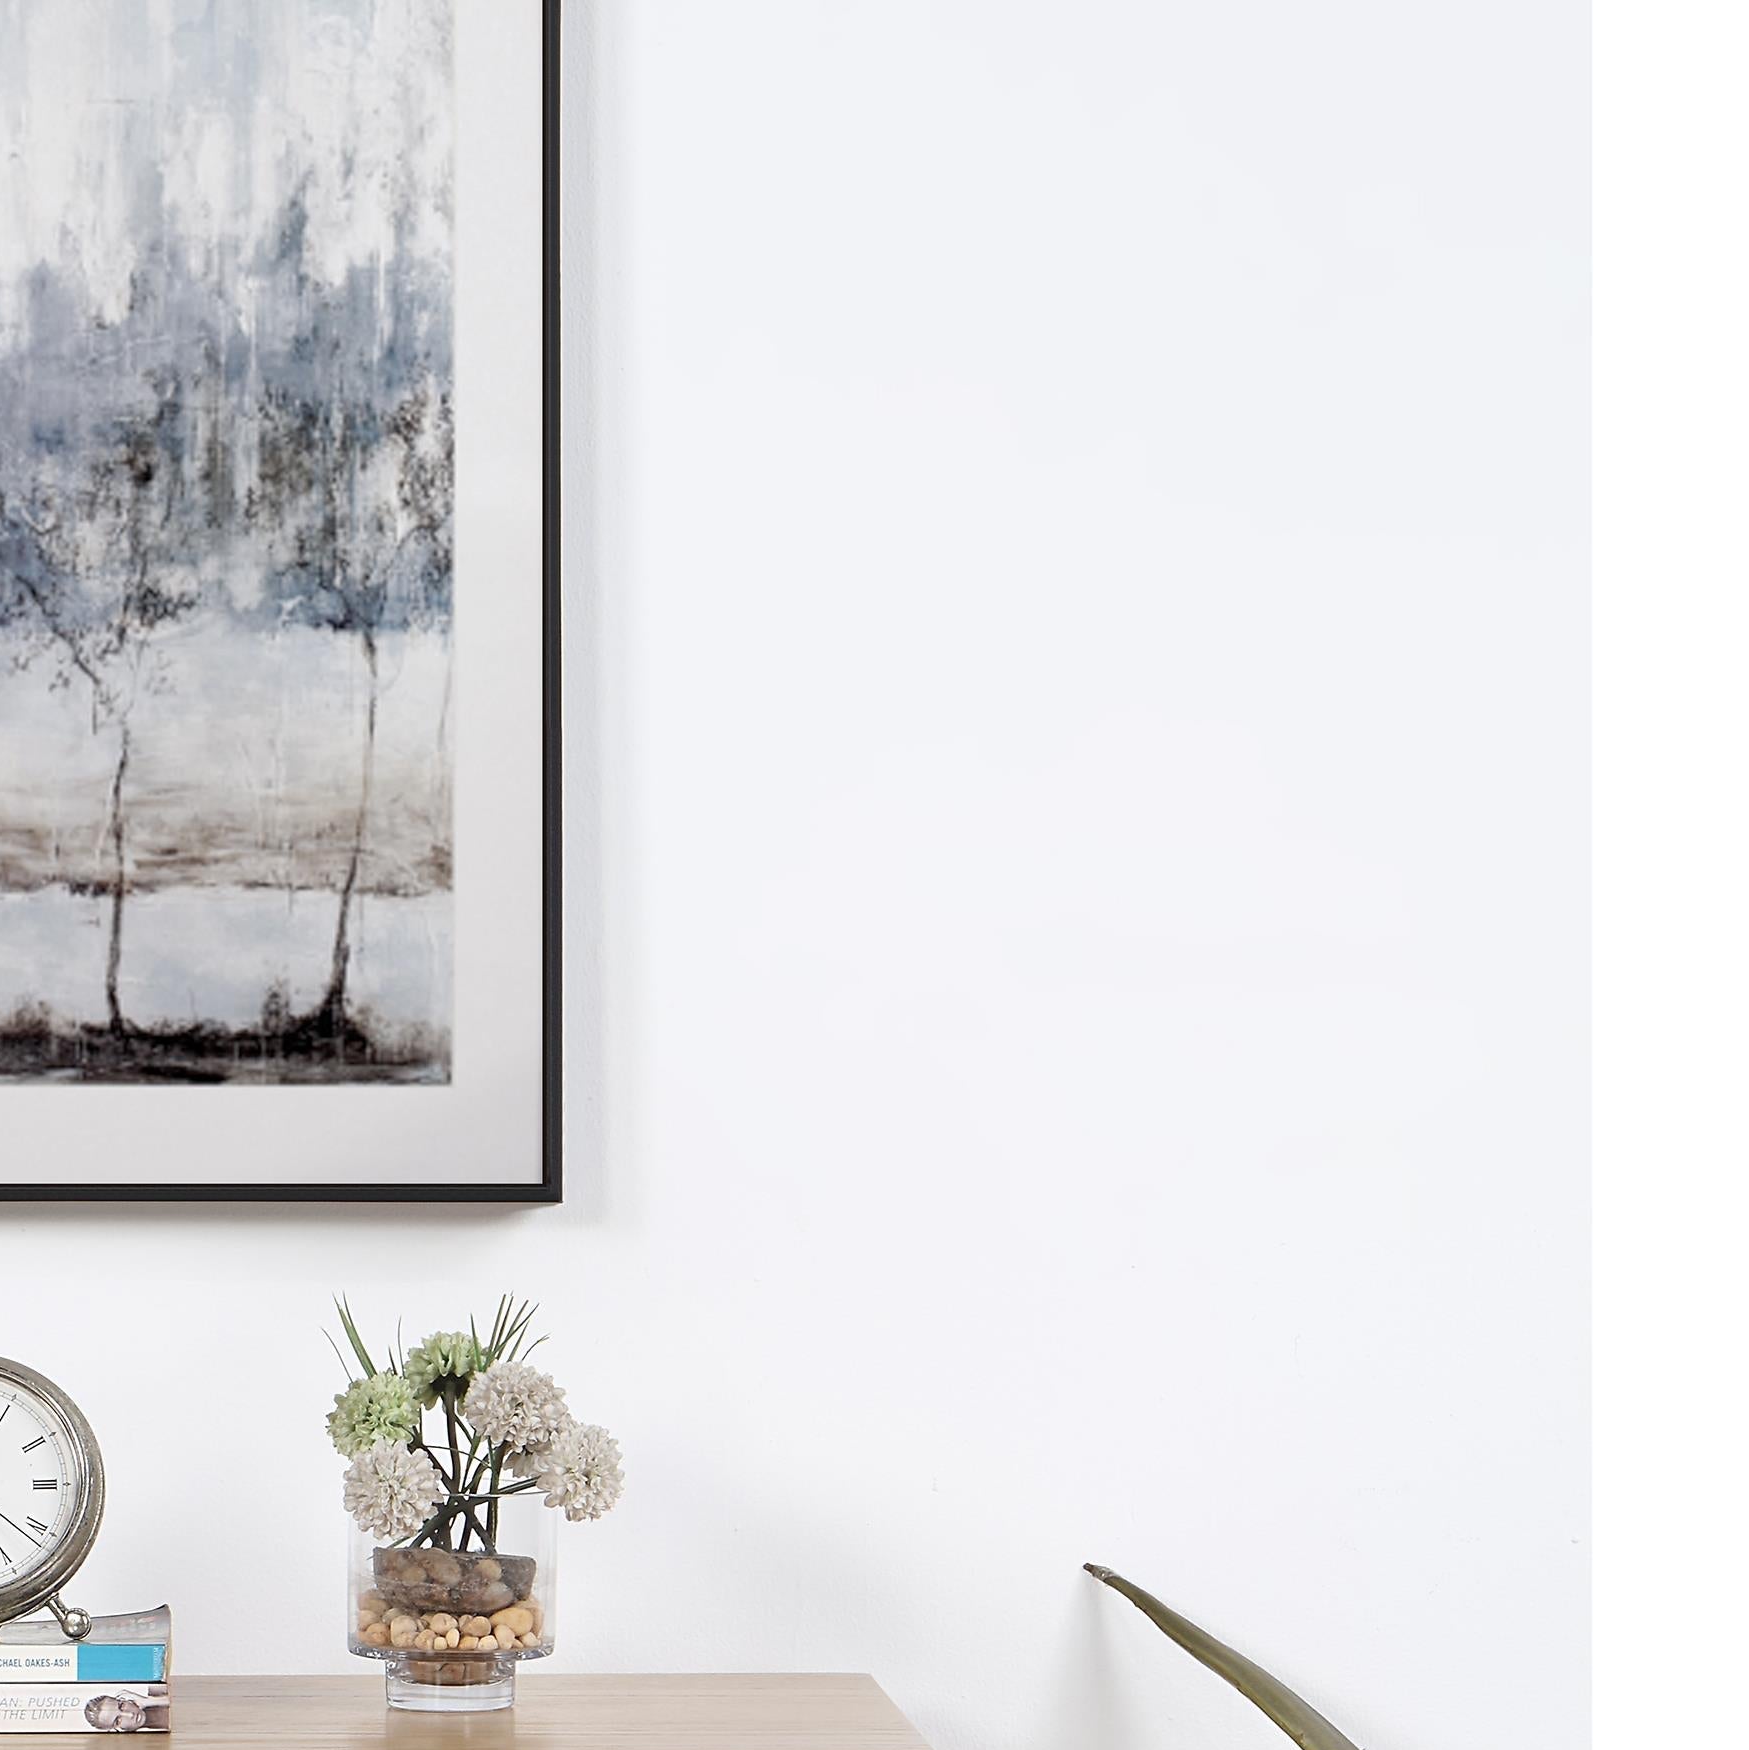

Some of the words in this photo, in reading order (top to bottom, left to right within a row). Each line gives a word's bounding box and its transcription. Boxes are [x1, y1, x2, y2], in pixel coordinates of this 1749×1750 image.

[22, 1436, 46, 1453] II
[32, 1479, 57, 1491] III
[25, 1658, 70, 1668] OAKES-ASH
[28, 1697, 80, 1707] PUSHED
[2, 1709, 27, 1720] THE
[31, 1709, 67, 1720] LIMIT
